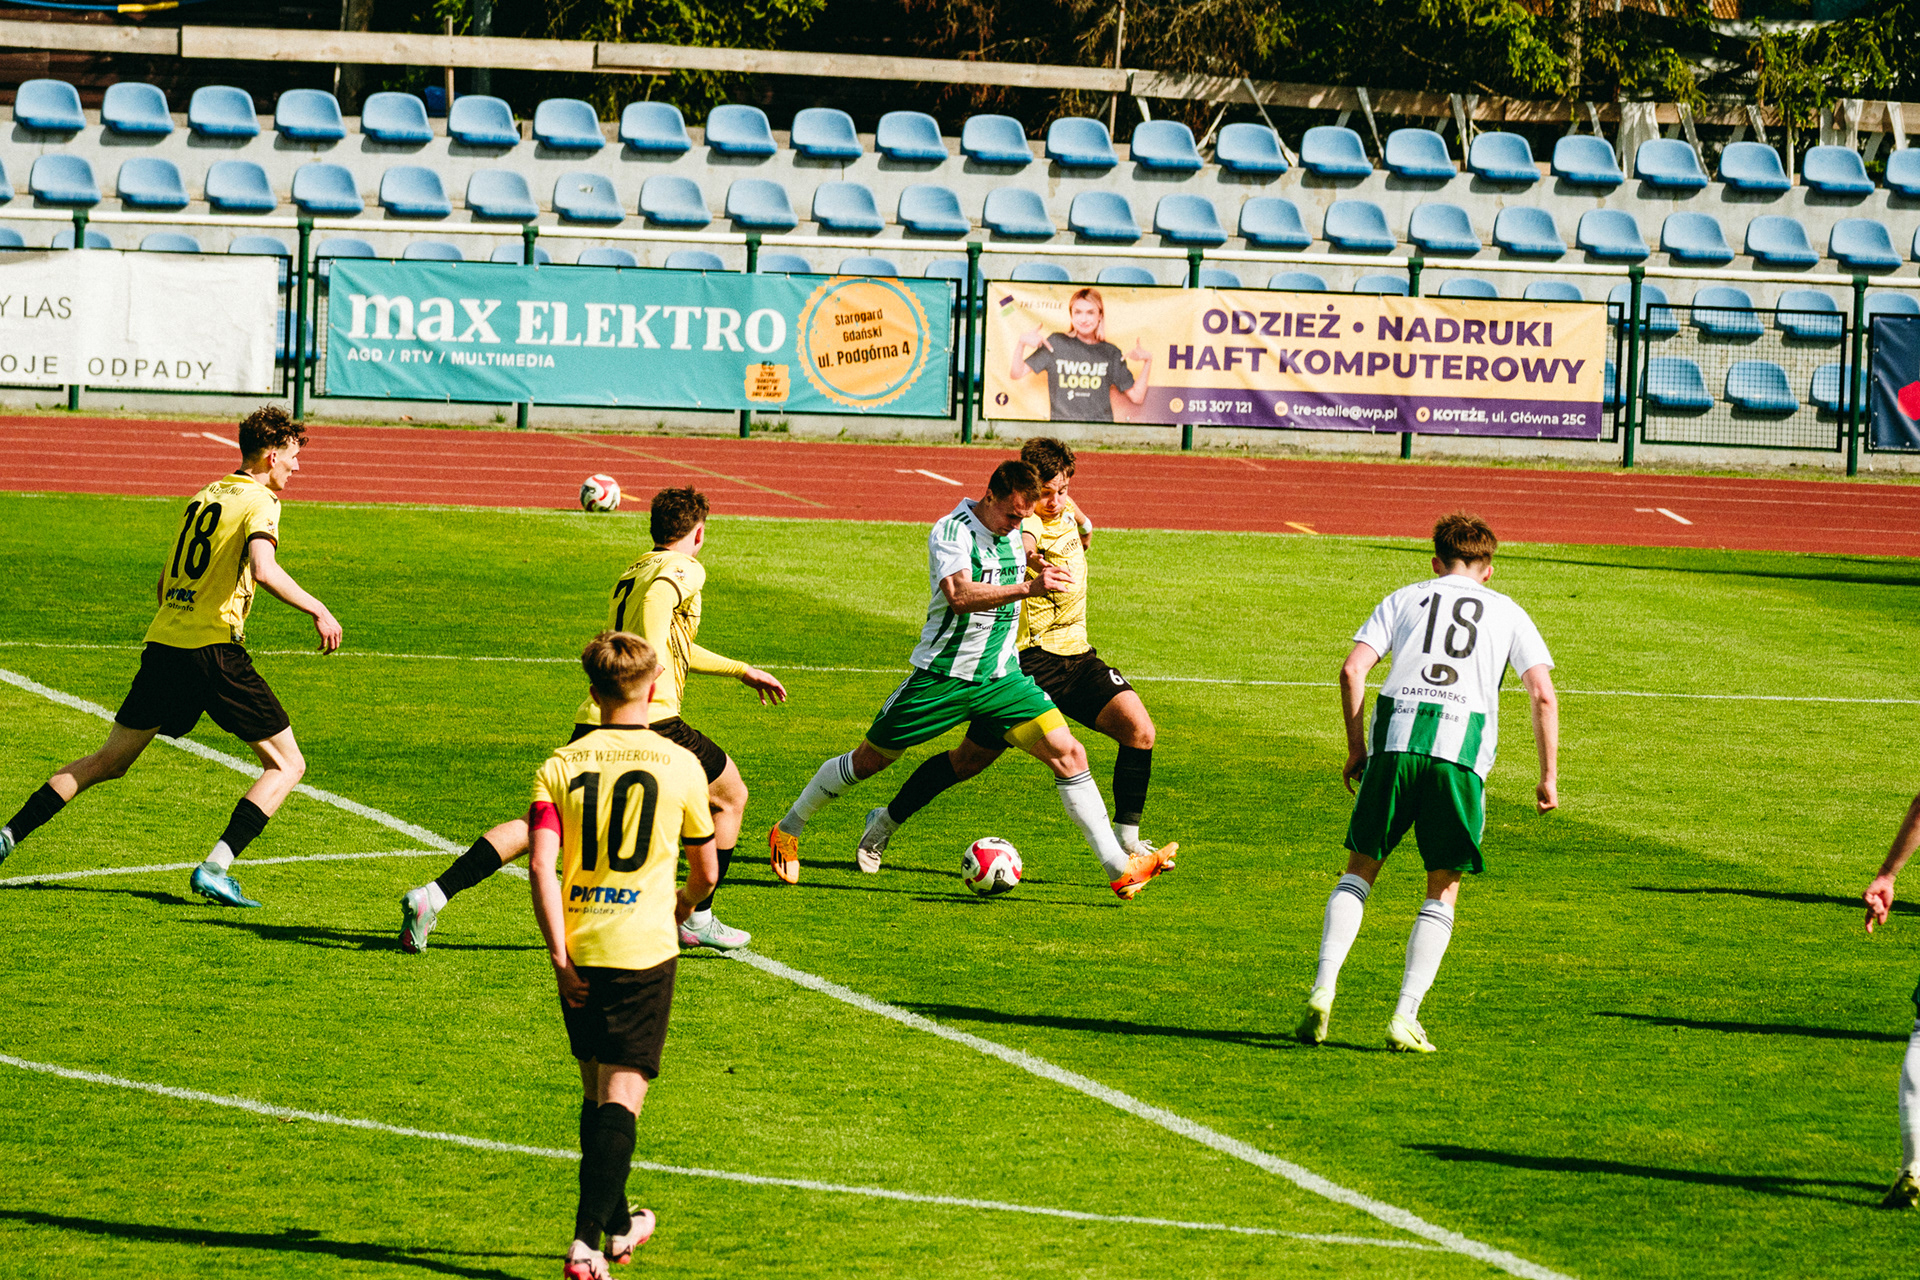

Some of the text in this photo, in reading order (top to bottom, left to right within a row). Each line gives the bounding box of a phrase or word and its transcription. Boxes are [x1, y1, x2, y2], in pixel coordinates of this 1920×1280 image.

[23, 296, 72, 319] LAS
[835, 308, 883, 327] Starogard
[348, 294, 787, 353] max ELEKTRO
[843, 325, 882, 342] Gdański
[1203, 304, 1552, 347] ODZIEŻ NADRUKI
[347, 347, 383, 362] AGD
[400, 350, 434, 364] RTV
[451, 351, 556, 368] MULTIMEDIA
[818, 340, 911, 368] ul. Podgórna 4
[1168, 345, 1585, 384] HAFT KOMPUTEROWY
[88, 357, 213, 380] ODPADY
[1056, 359, 1108, 376] TWOJE
[1059, 374, 1102, 389] LOGO
[1188, 400, 1252, 413] 513 307 121
[1293, 404, 1398, 420] tre-stelle@wp.pl
[1433, 407, 1586, 425] KOTEŻE, ul. Główna 25C
[171, 501, 222, 580] 18
[613, 577, 636, 632] 7
[1419, 592, 1484, 659] 18
[1109, 669, 1124, 685] 6
[1402, 687, 1467, 704] DARTOMEKS
[564, 749, 671, 765] GRYF WEJHEROWO
[569, 769, 659, 872] 10
